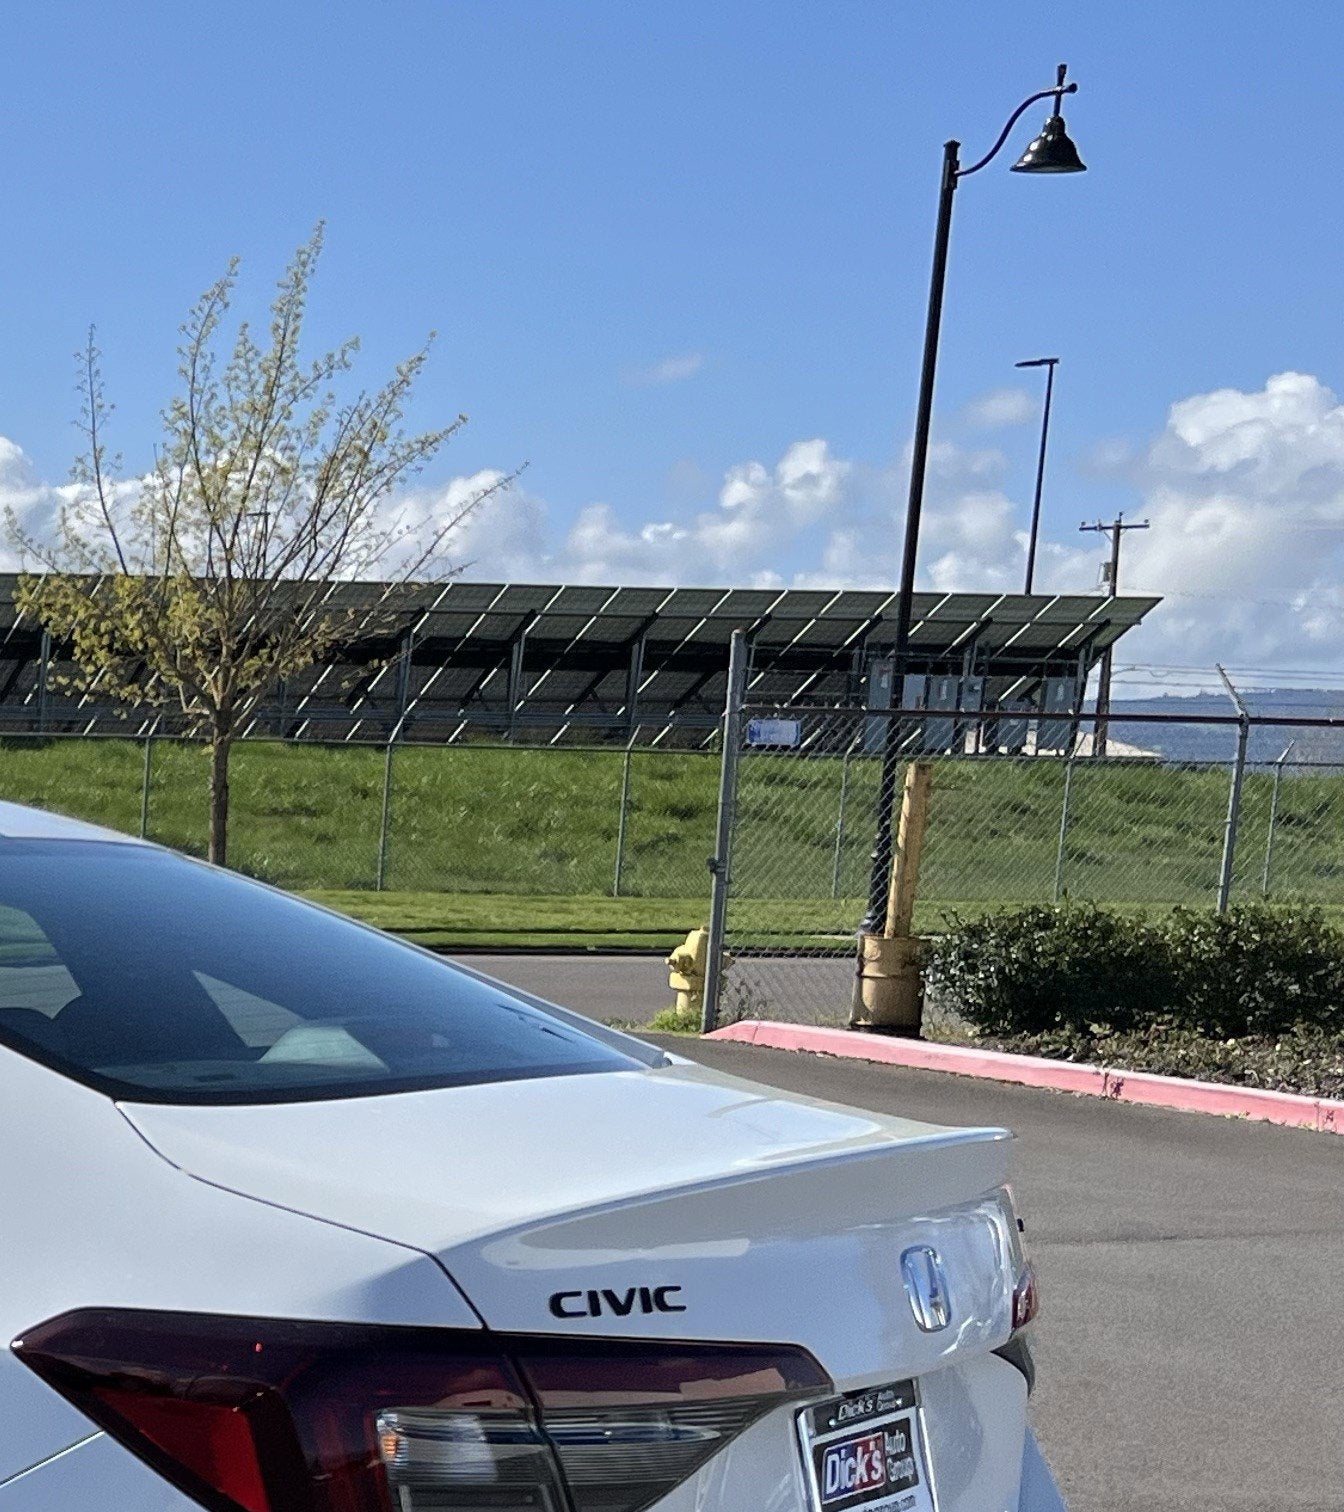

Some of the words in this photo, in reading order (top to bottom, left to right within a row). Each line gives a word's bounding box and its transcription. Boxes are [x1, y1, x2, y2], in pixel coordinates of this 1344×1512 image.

[548, 1285, 687, 1319] CIVIC
[825, 1439, 884, 1495] Dick's
[885, 1429, 907, 1455] Auto
[886, 1455, 914, 1483] Group
